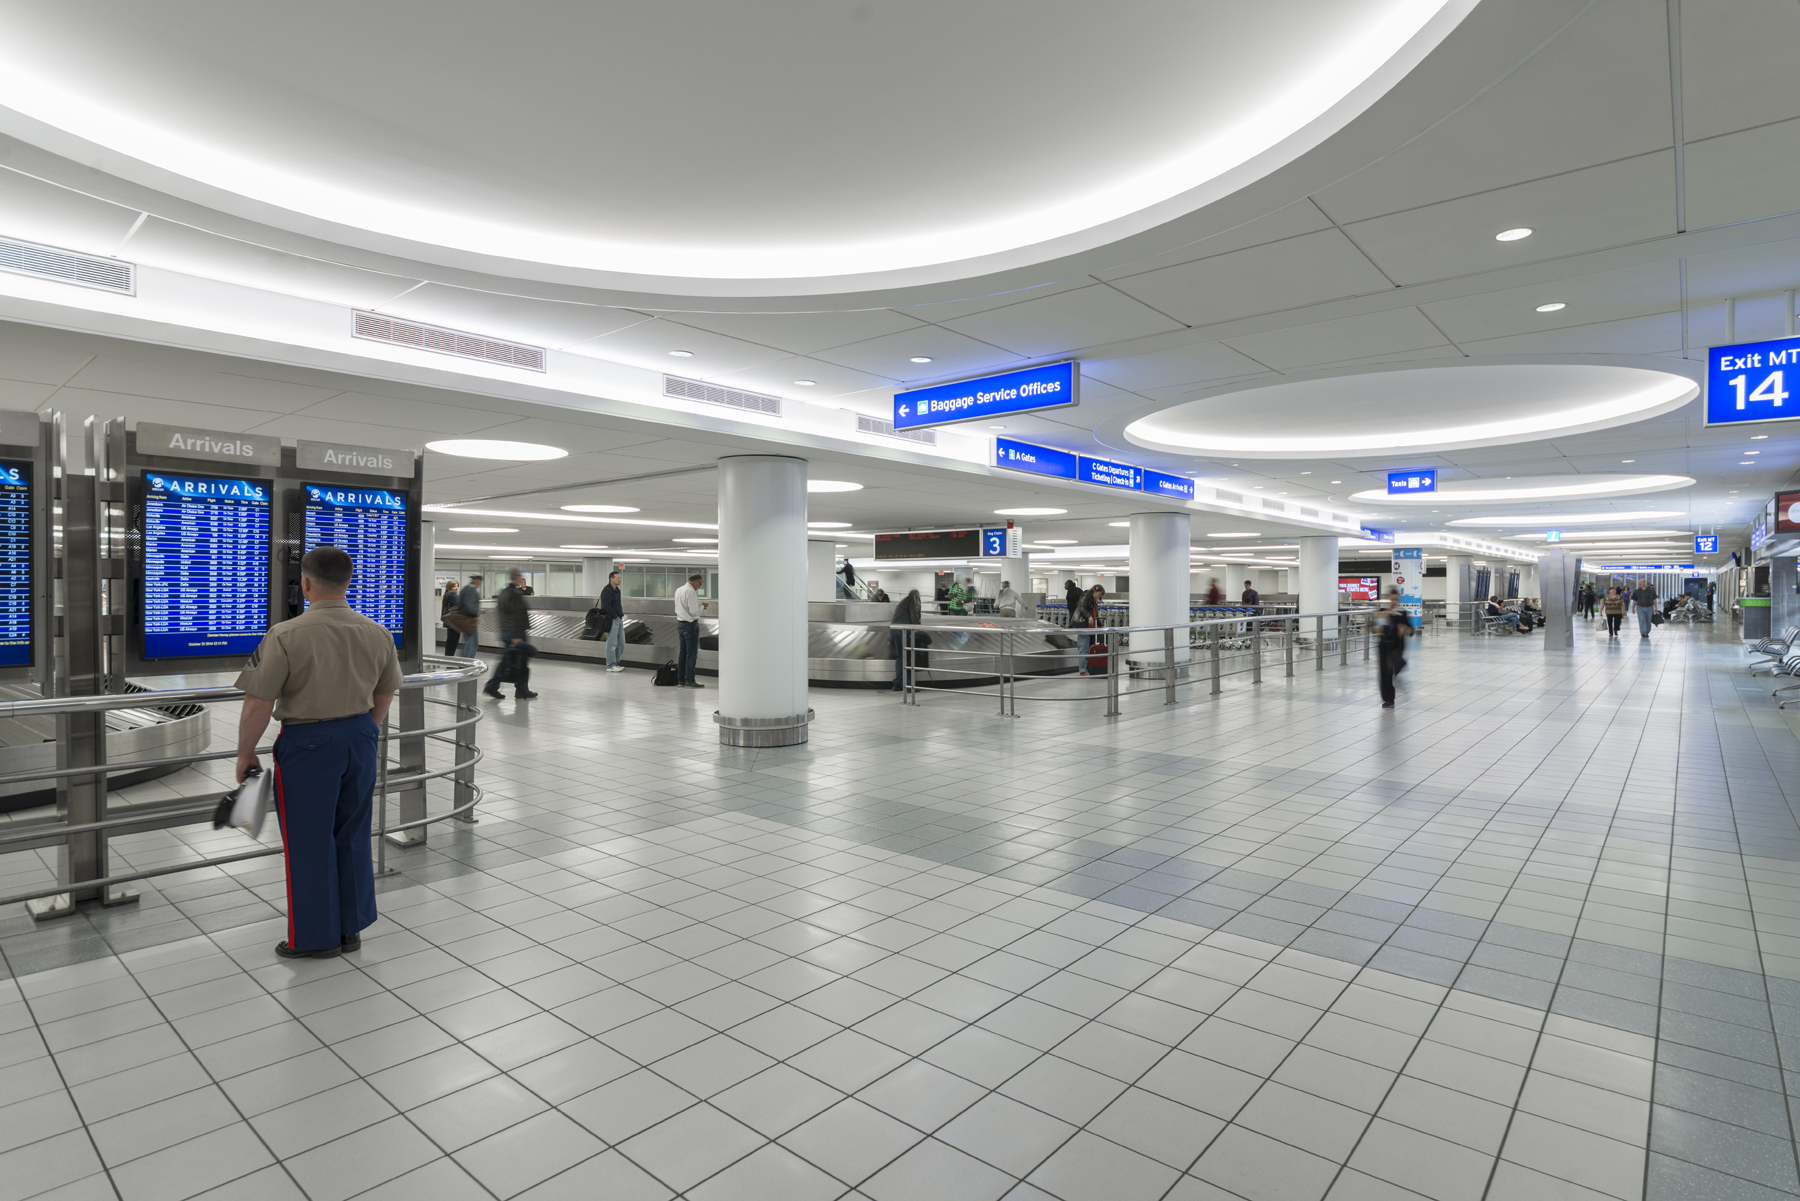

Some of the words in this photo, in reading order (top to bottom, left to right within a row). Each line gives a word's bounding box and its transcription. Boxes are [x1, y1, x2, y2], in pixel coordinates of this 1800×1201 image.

[1721, 353, 1762, 371] Exit
[1769, 349, 1800, 366] MT
[930, 396, 974, 412] Baggage
[976, 388, 1018, 404] Service
[1019, 381, 1061, 397] Offices
[1729, 371, 1789, 410] 14
[169, 433, 254, 457] Arrivals
[323, 449, 393, 469] Arrivals
[1016, 452, 1021, 460] A
[1021, 452, 1036, 463] Gates
[1097, 464, 1108, 473] Gates
[1109, 466, 1129, 477] Departures
[1092, 472, 1110, 484] Ticketing
[1113, 476, 1129, 486] Check-in
[1159, 480, 1163, 488] C
[1391, 480, 1407, 488] Taxis
[170, 480, 263, 497] ARRIVALS
[325, 491, 401, 506] ARRIVALS
[990, 537, 1000, 555] 3
[1698, 541, 1713, 551] 12
